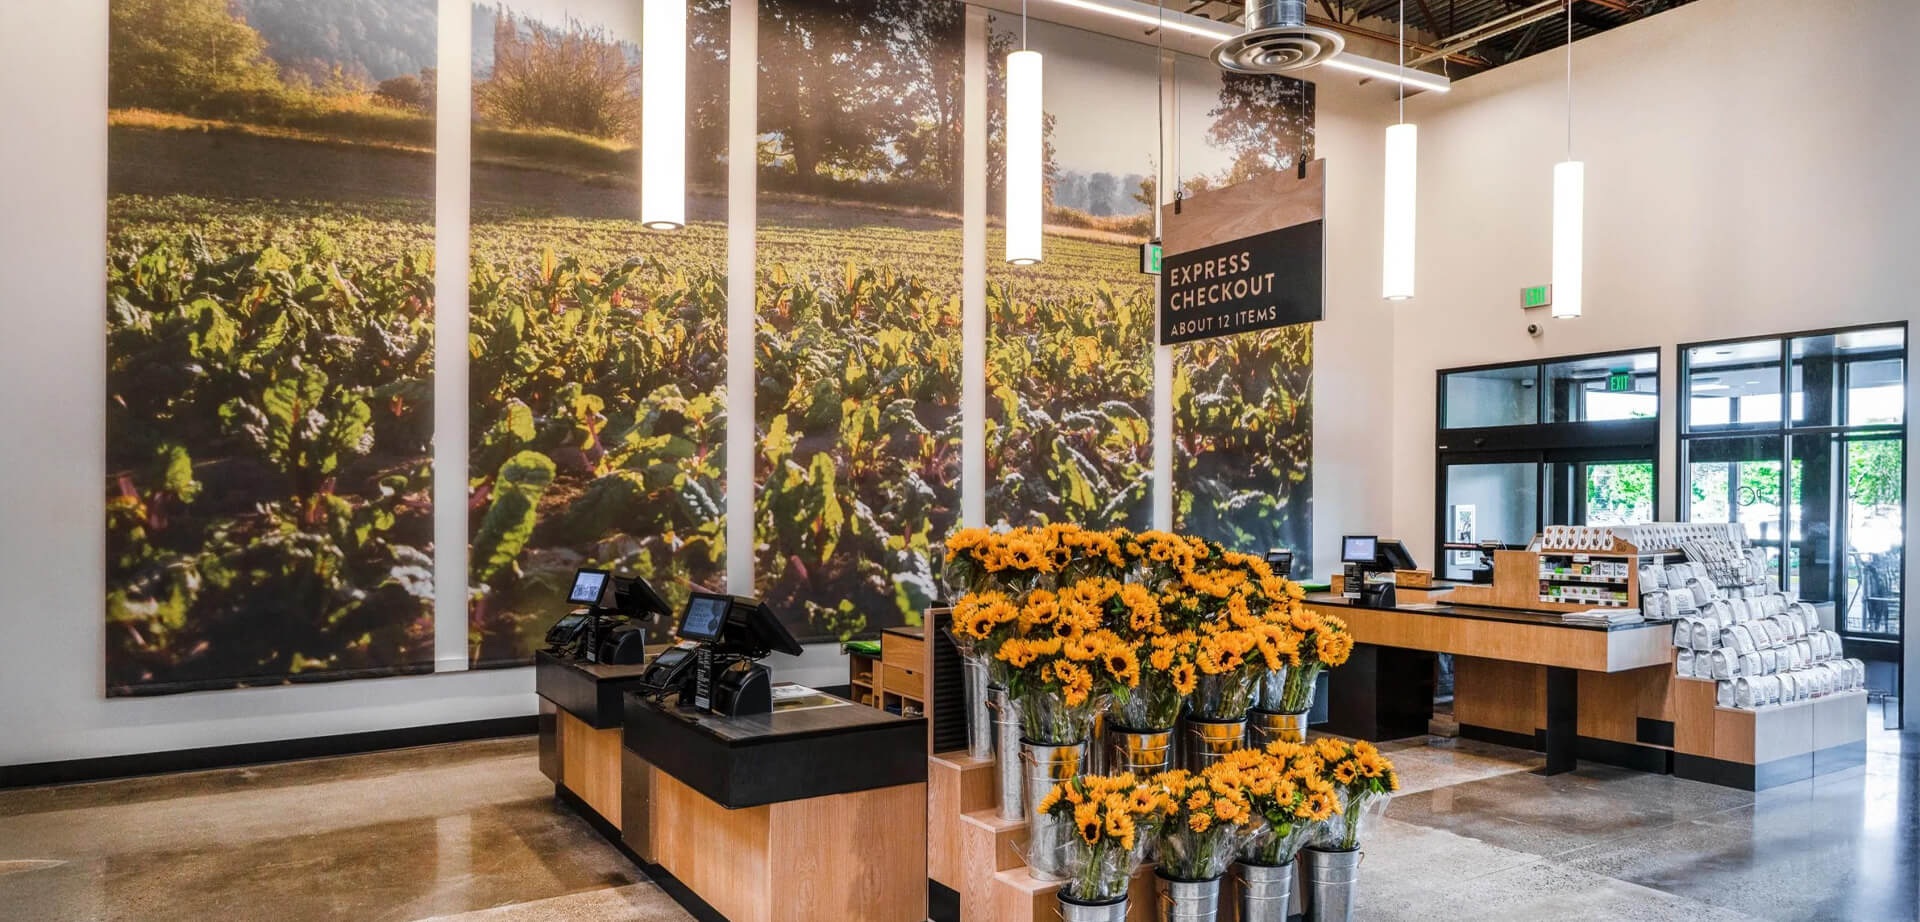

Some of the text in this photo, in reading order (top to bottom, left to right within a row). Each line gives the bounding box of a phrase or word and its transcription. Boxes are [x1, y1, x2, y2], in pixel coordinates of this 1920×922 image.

[1170, 252, 1250, 287] EXPRESS
[1170, 273, 1275, 311] CHECKOUT
[1526, 286, 1546, 306] EXIT
[1170, 306, 1277, 337] ABOUT 12 ITEMS
[1610, 375, 1629, 391] EXIT
